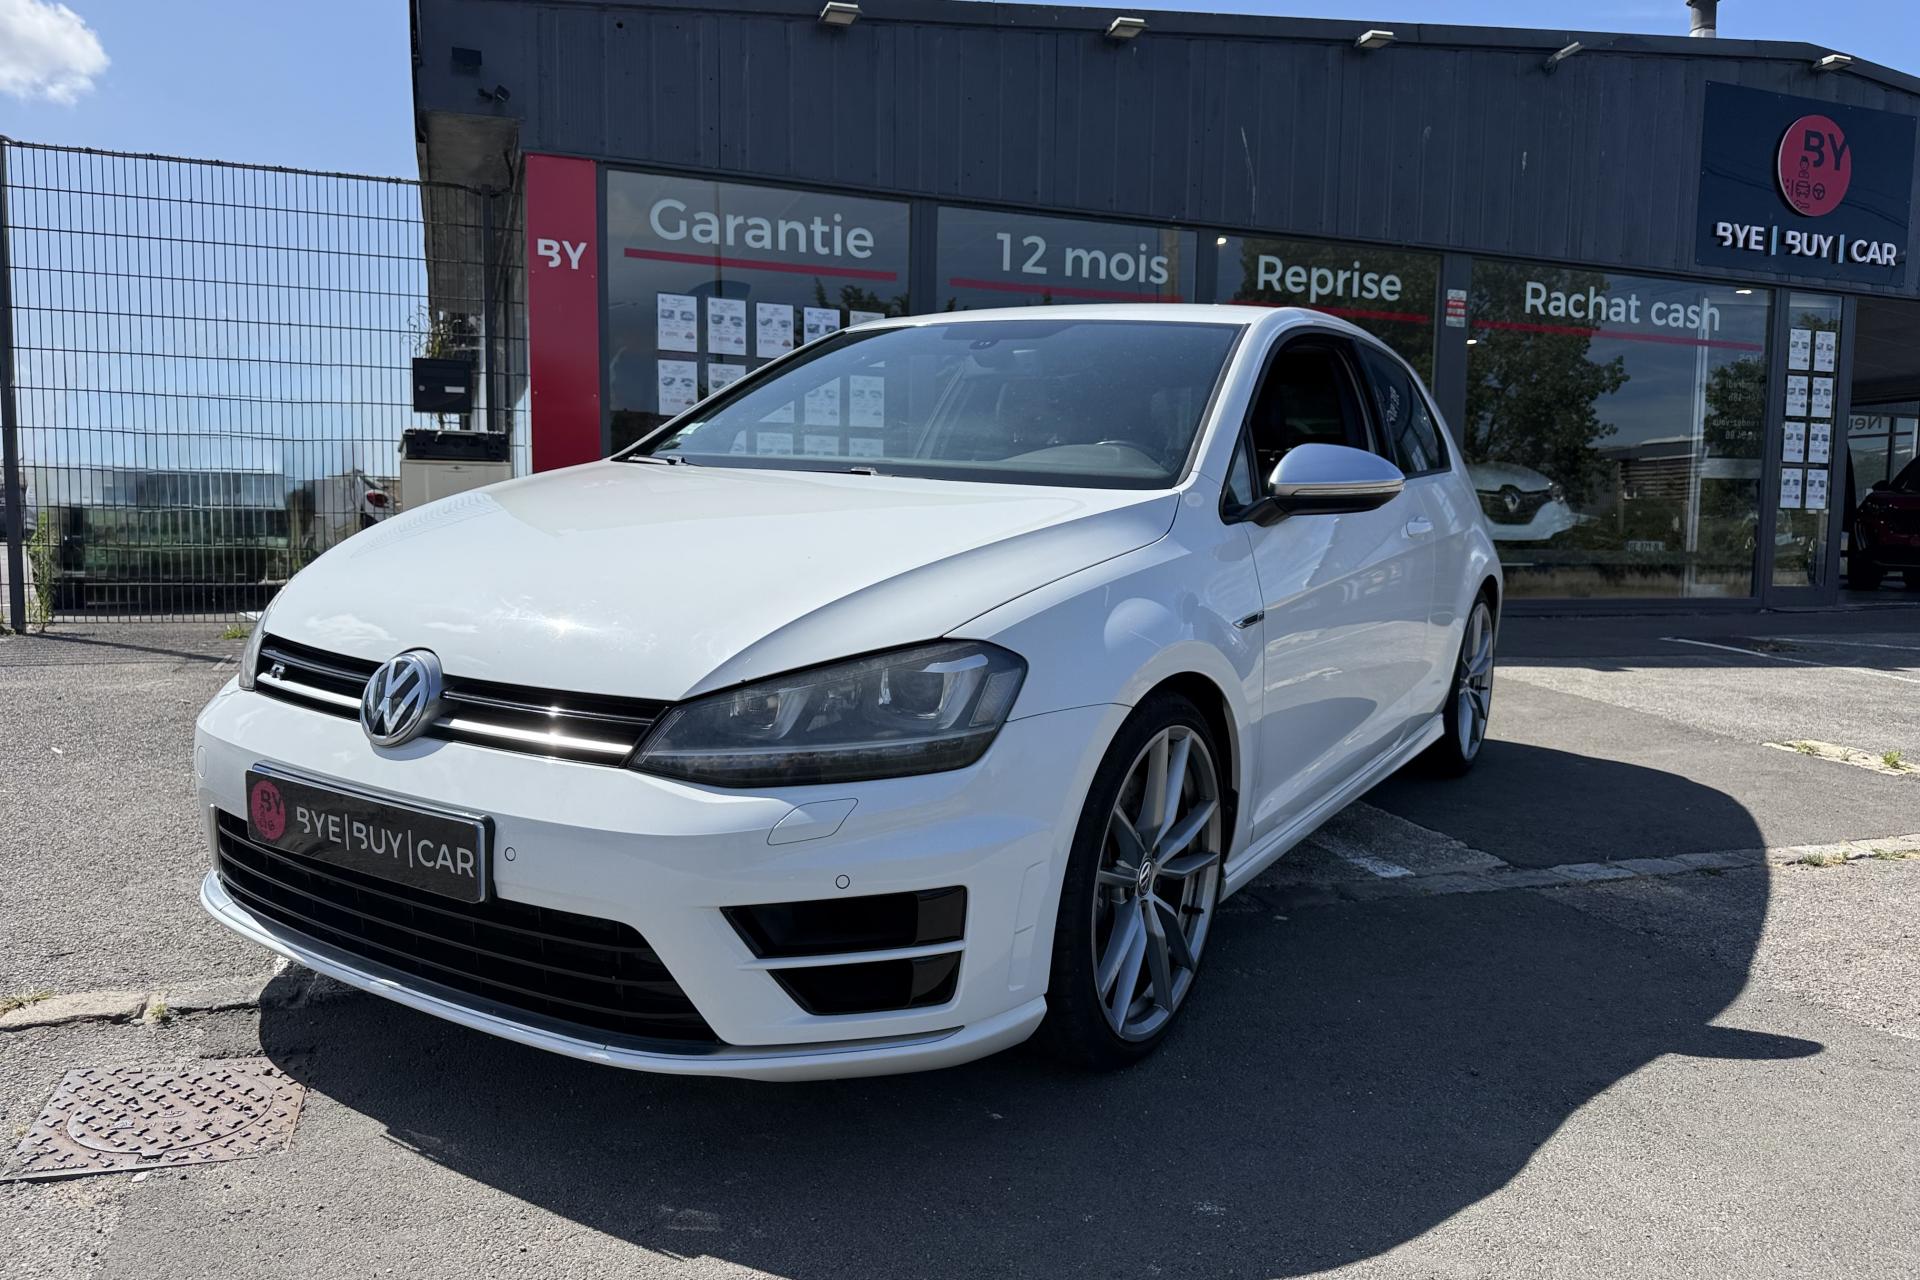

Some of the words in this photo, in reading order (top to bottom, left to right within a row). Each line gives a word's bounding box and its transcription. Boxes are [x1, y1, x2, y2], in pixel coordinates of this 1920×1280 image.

[1803, 129, 1851, 171] BY
[537, 238, 587, 270] BY
[649, 199, 874, 259] Garantie
[1715, 221, 1765, 251] BYE
[1785, 230, 1834, 258] BUY
[1850, 239, 1897, 266] CAR
[996, 232, 1047, 275] 12
[1065, 243, 1169, 285] mois
[1257, 254, 1402, 304] Reprise
[1524, 281, 1641, 325] Rachat
[1650, 297, 1720, 332] cash
[261, 790, 283, 815] BY
[296, 806, 342, 845] BYE
[351, 821, 403, 860] BUY
[416, 839, 475, 878] CAR
